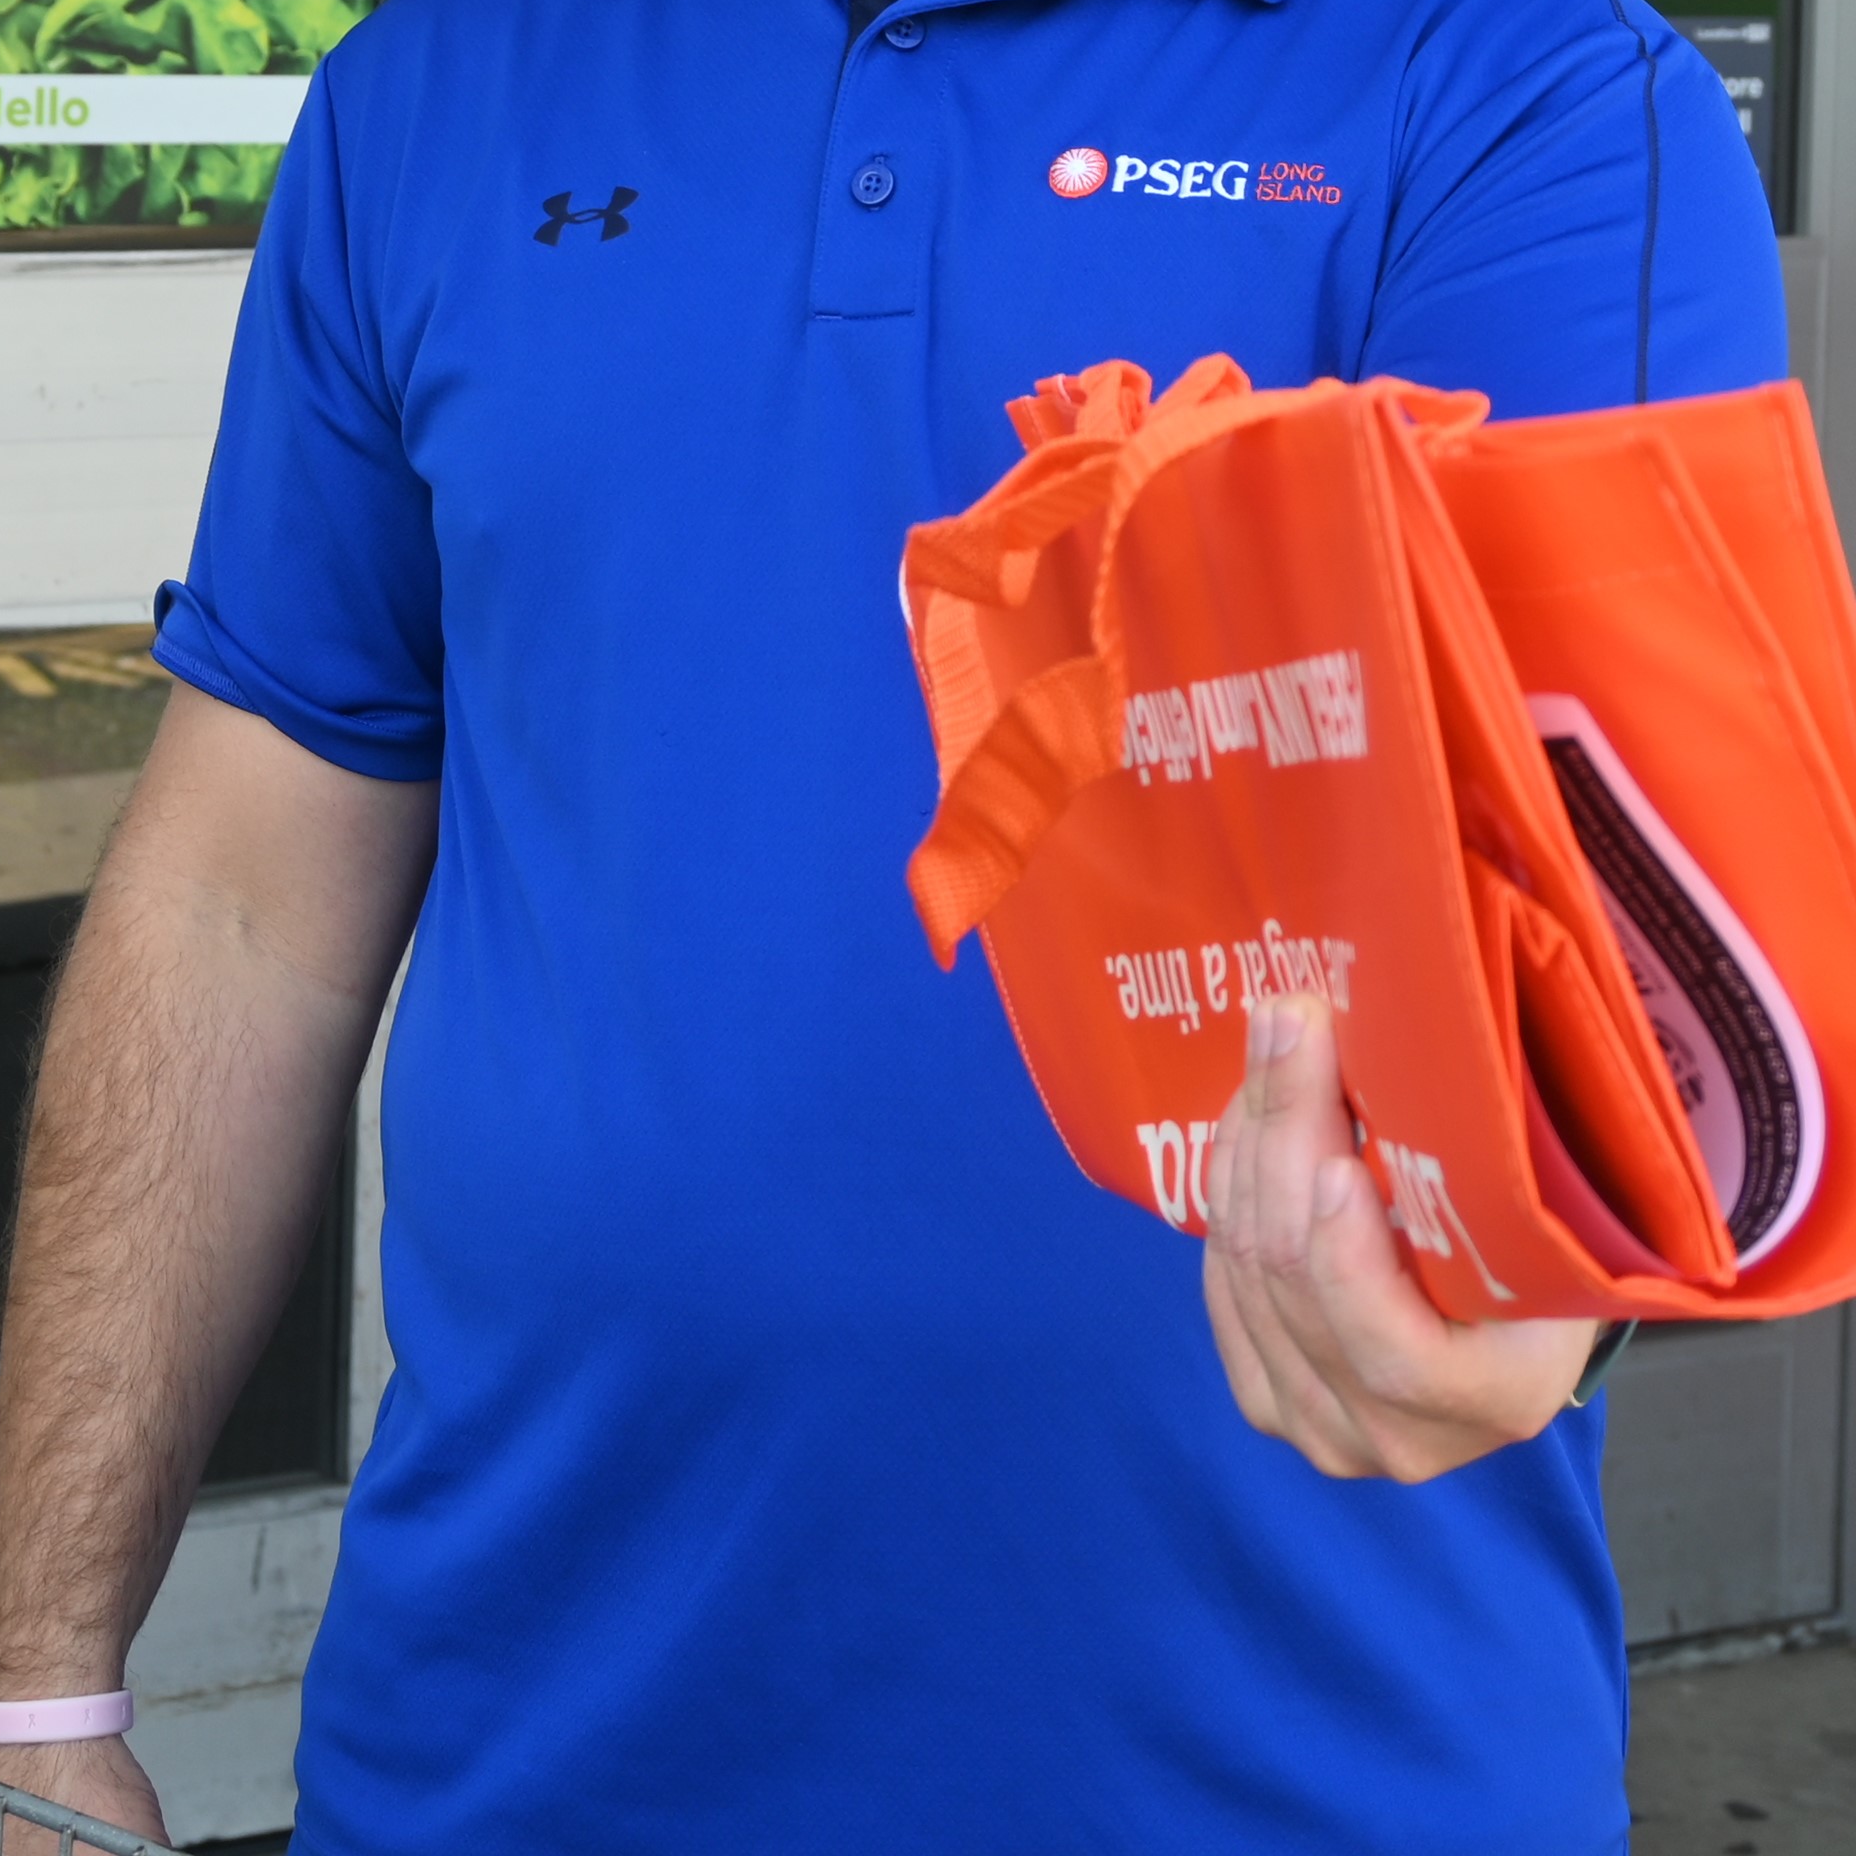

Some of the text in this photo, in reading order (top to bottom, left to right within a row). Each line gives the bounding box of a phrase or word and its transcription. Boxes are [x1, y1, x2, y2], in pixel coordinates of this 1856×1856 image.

[1112, 154, 1249, 200] PSEG
[1255, 183, 1342, 204] ISLAND
[1258, 162, 1326, 182] LONG
[1104, 947, 1200, 1034] time.
[1200, 942, 1228, 1013] a
